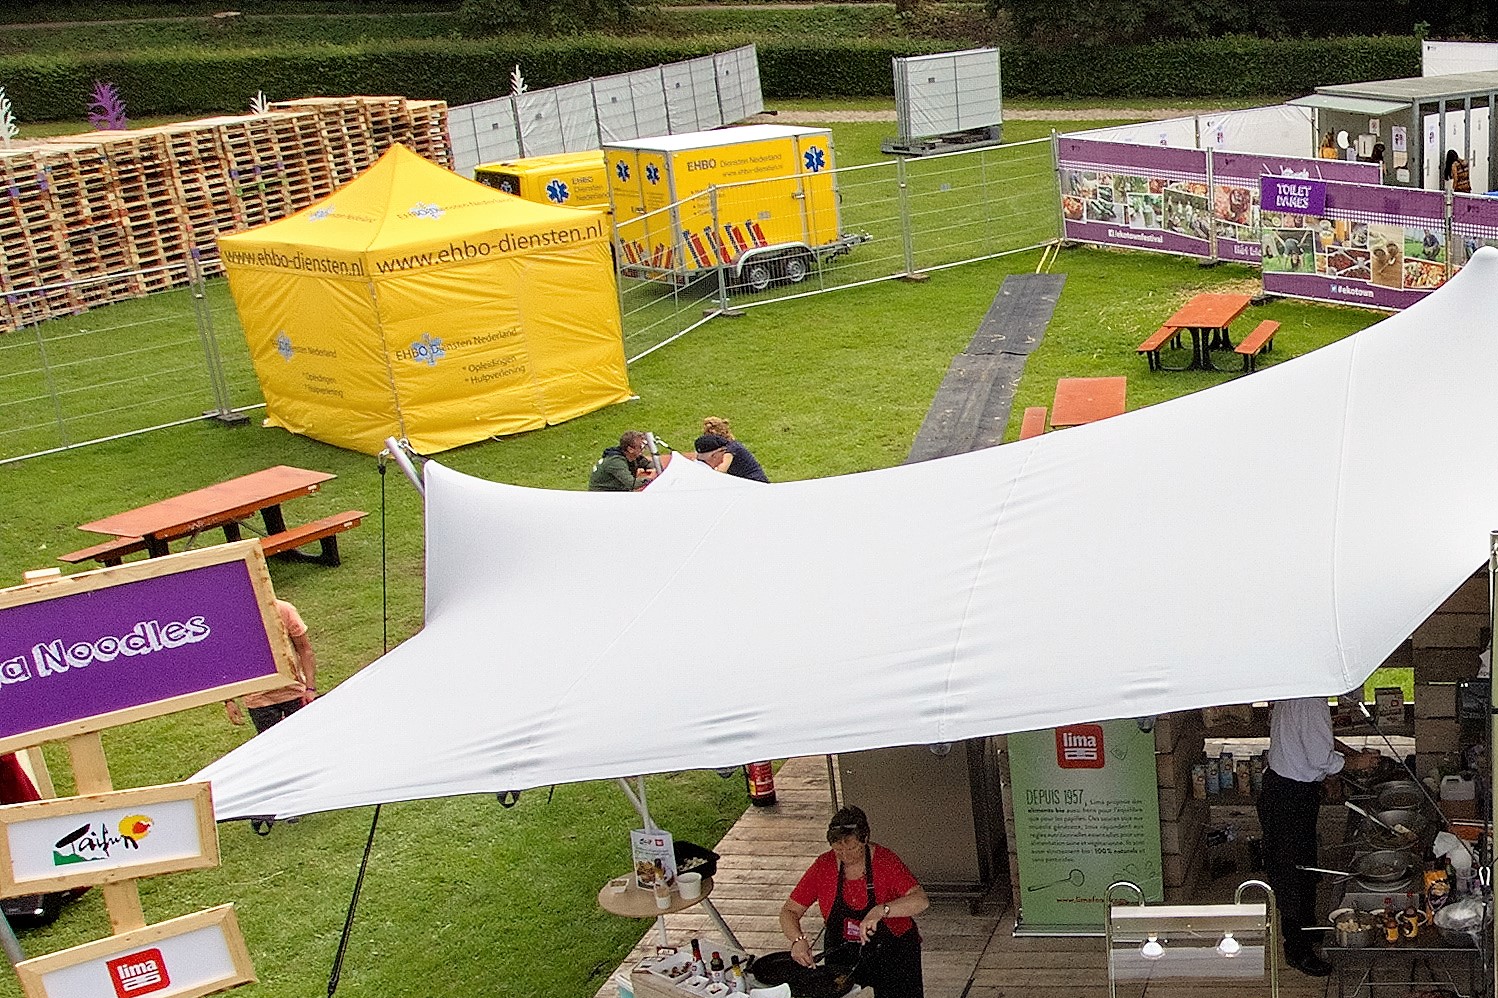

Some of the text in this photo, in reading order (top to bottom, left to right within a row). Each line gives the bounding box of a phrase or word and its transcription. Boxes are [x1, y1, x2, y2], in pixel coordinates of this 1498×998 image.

[687, 159, 717, 171] EHBO
[1276, 183, 1311, 197] TOILET
[1276, 195, 1309, 209] DAMES
[376, 220, 603, 274] www.ehbo-diensten.nl
[224, 249, 364, 276] www.ehbo-diensten.nl
[473, 327, 518, 344] Nederland
[32, 615, 211, 678] Noodles
[1062, 732, 1097, 747] lima
[1026, 789, 1060, 805] DEPUIS
[117, 959, 158, 980] lima
